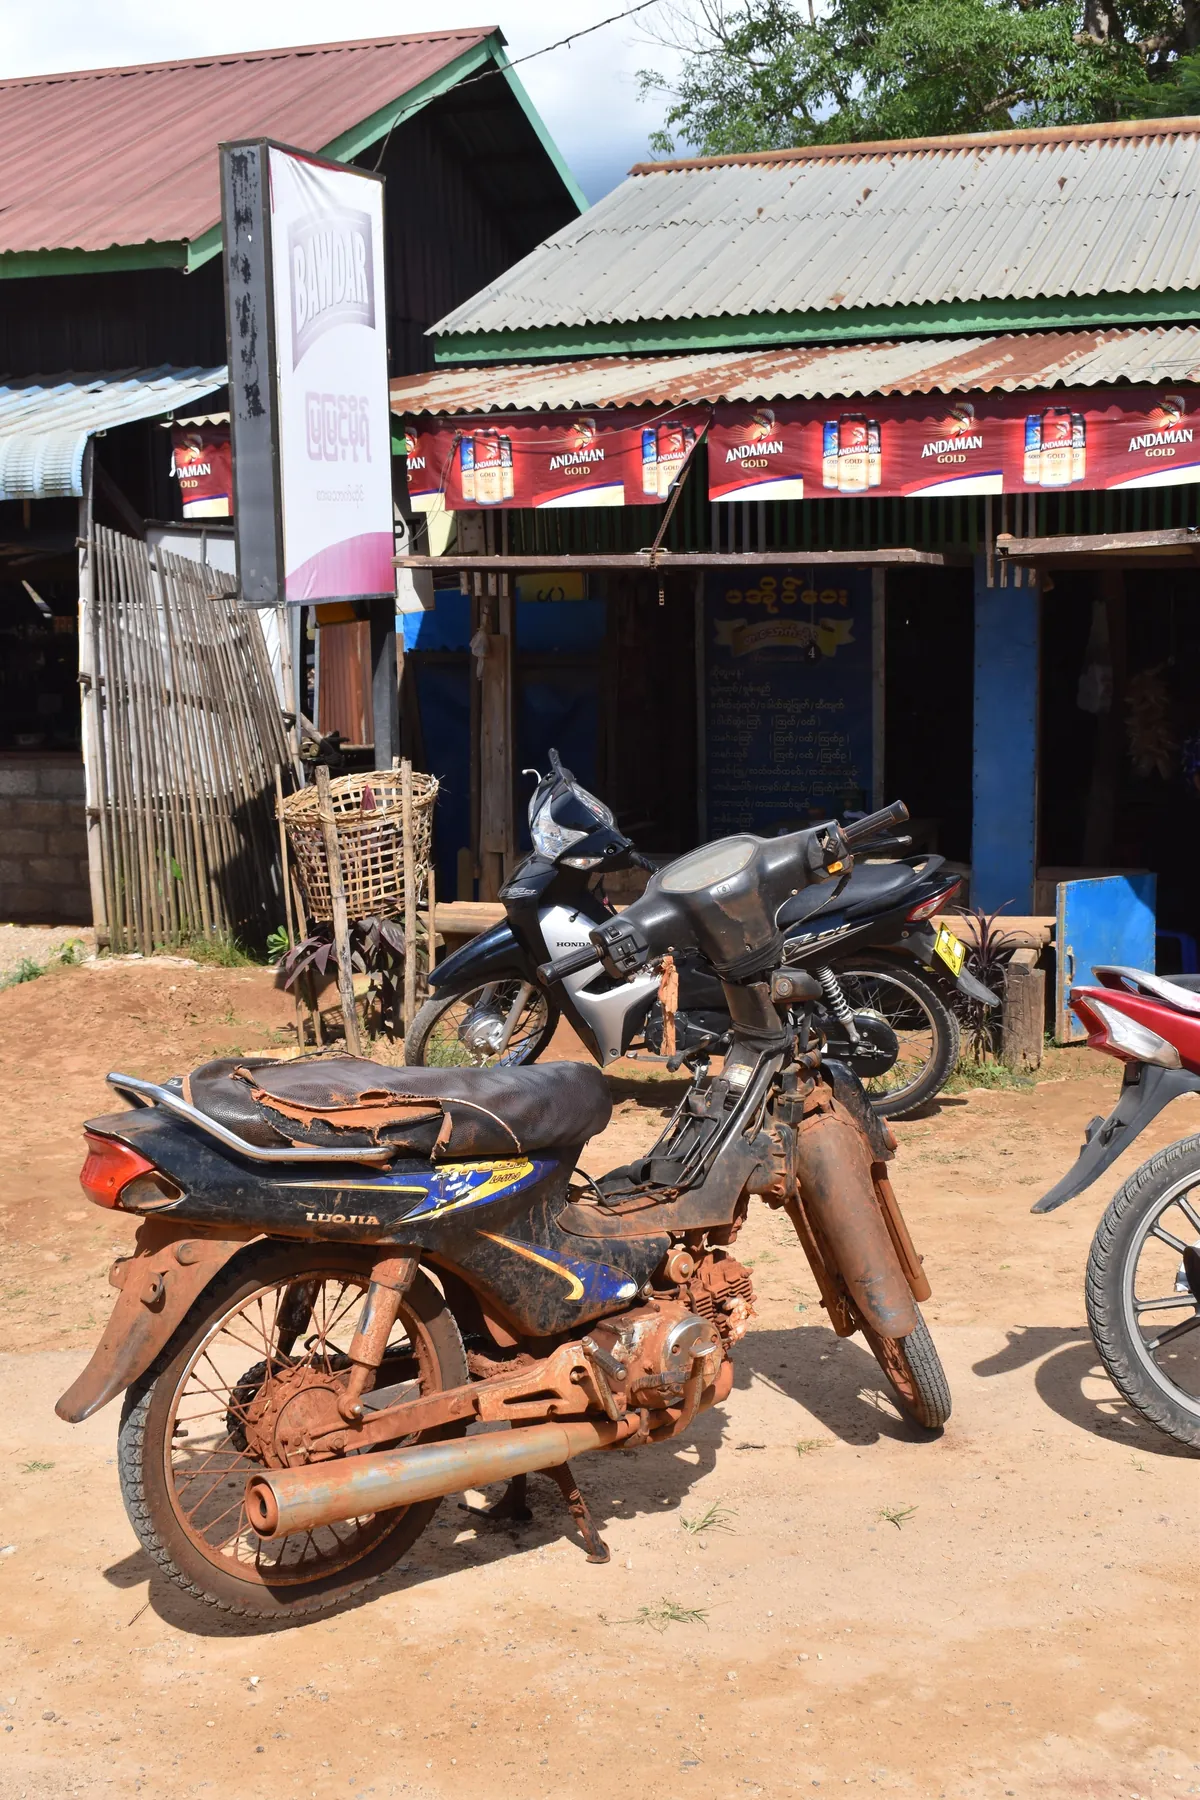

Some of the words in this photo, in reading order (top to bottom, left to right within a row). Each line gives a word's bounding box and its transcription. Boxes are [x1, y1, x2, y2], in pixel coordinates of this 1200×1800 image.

[294, 228, 369, 334] BAWDAR
[921, 436, 983, 458] ANDAMAN
[1040, 440, 1072, 450] ANDAMAN
[1128, 429, 1193, 452] ANDAMAN
[725, 441, 783, 463] ANDAMAN
[1145, 448, 1175, 456] GOLD
[550, 449, 604, 470] ANDAMAN
[741, 459, 769, 468] GOLD
[937, 454, 966, 464] GOLD
[564, 466, 590, 476] GOLD
[180, 480, 198, 488] OLD
[807, 646, 816, 659] 4
[305, 1212, 380, 1225] LUOJIA
